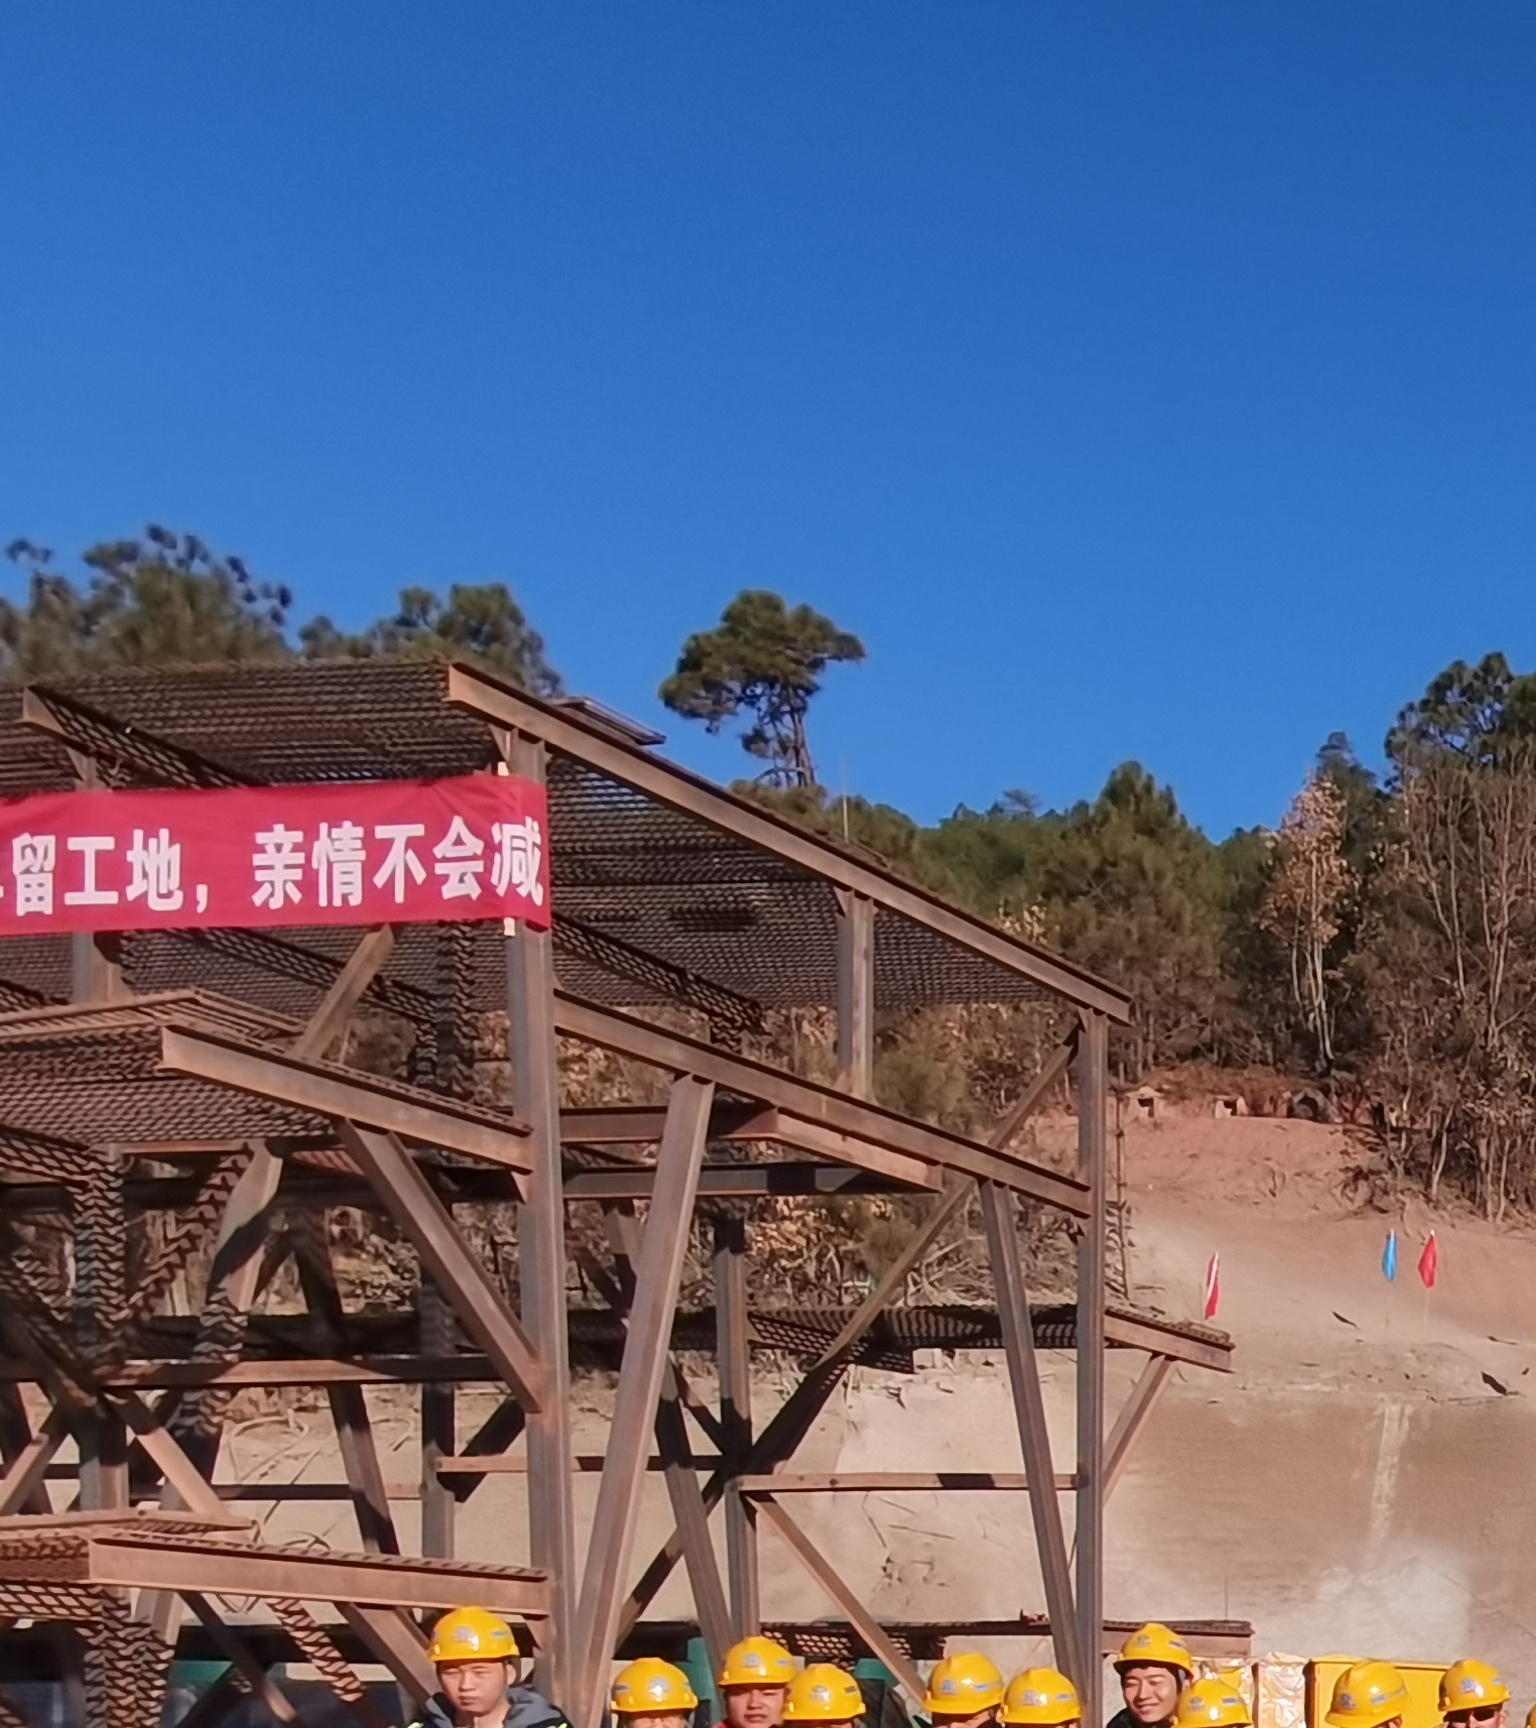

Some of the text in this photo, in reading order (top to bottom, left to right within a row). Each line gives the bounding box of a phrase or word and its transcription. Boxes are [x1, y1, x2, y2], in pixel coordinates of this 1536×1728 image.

[0, 815, 545, 917] 留工地，亲情不会减
